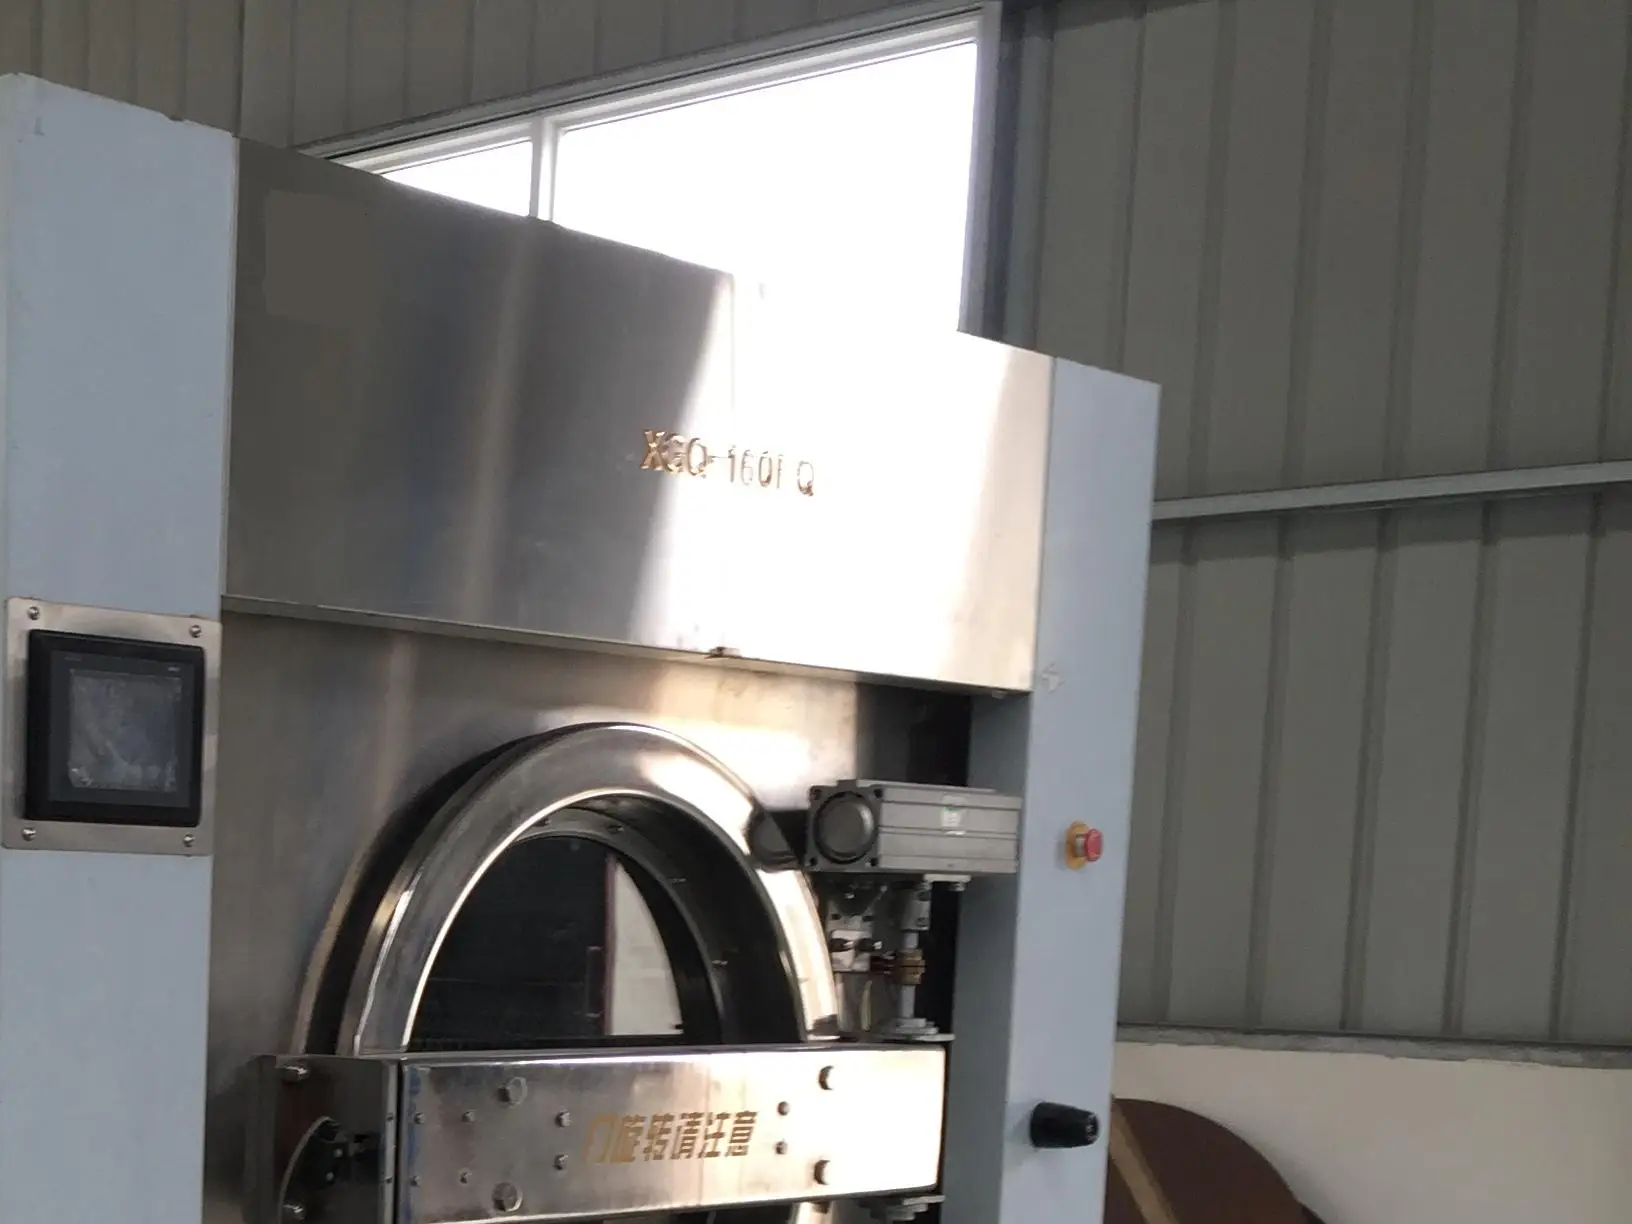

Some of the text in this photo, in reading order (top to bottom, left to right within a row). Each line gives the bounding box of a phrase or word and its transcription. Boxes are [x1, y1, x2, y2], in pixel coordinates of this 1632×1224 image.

[582, 1111, 757, 1163] 门旋转请注意
